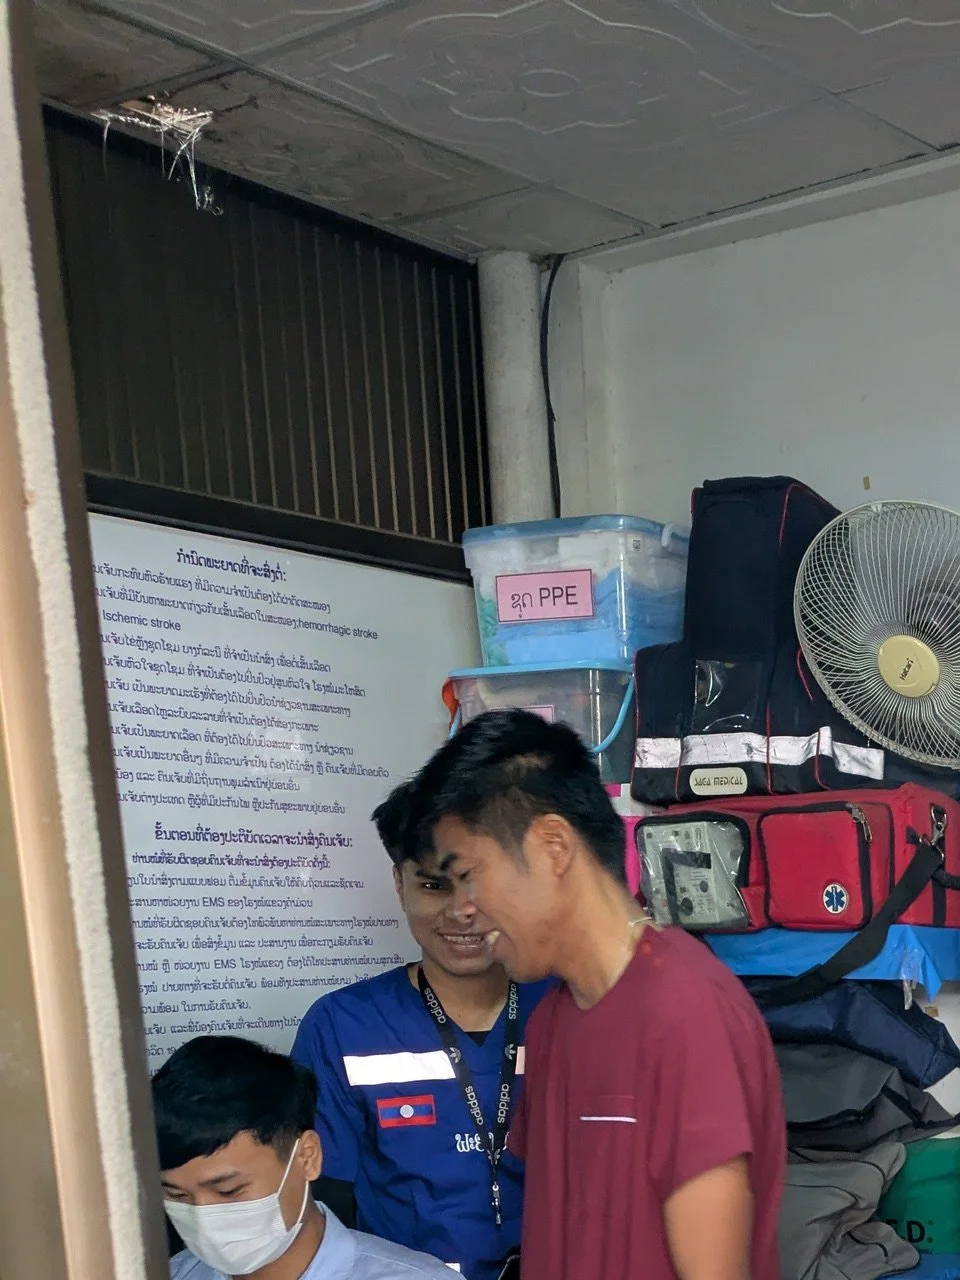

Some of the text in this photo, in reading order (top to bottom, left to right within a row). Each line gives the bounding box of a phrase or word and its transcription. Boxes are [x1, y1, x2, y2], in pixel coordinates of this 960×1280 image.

[539, 585, 578, 607] PPE
[102, 609, 180, 632] Ischemic stroke
[353, 628, 378, 640] stroke
[899, 657, 914, 681] Hatari
[136, 768, 154, 784] ແລະ
[202, 897, 224, 908] EMS
[238, 937, 254, 952] ແລະ
[214, 957, 235, 968] EMS
[424, 987, 447, 1025] adidas
[508, 983, 518, 1021] adidas
[465, 1085, 484, 1126] adidas
[497, 1083, 511, 1124] adidas
